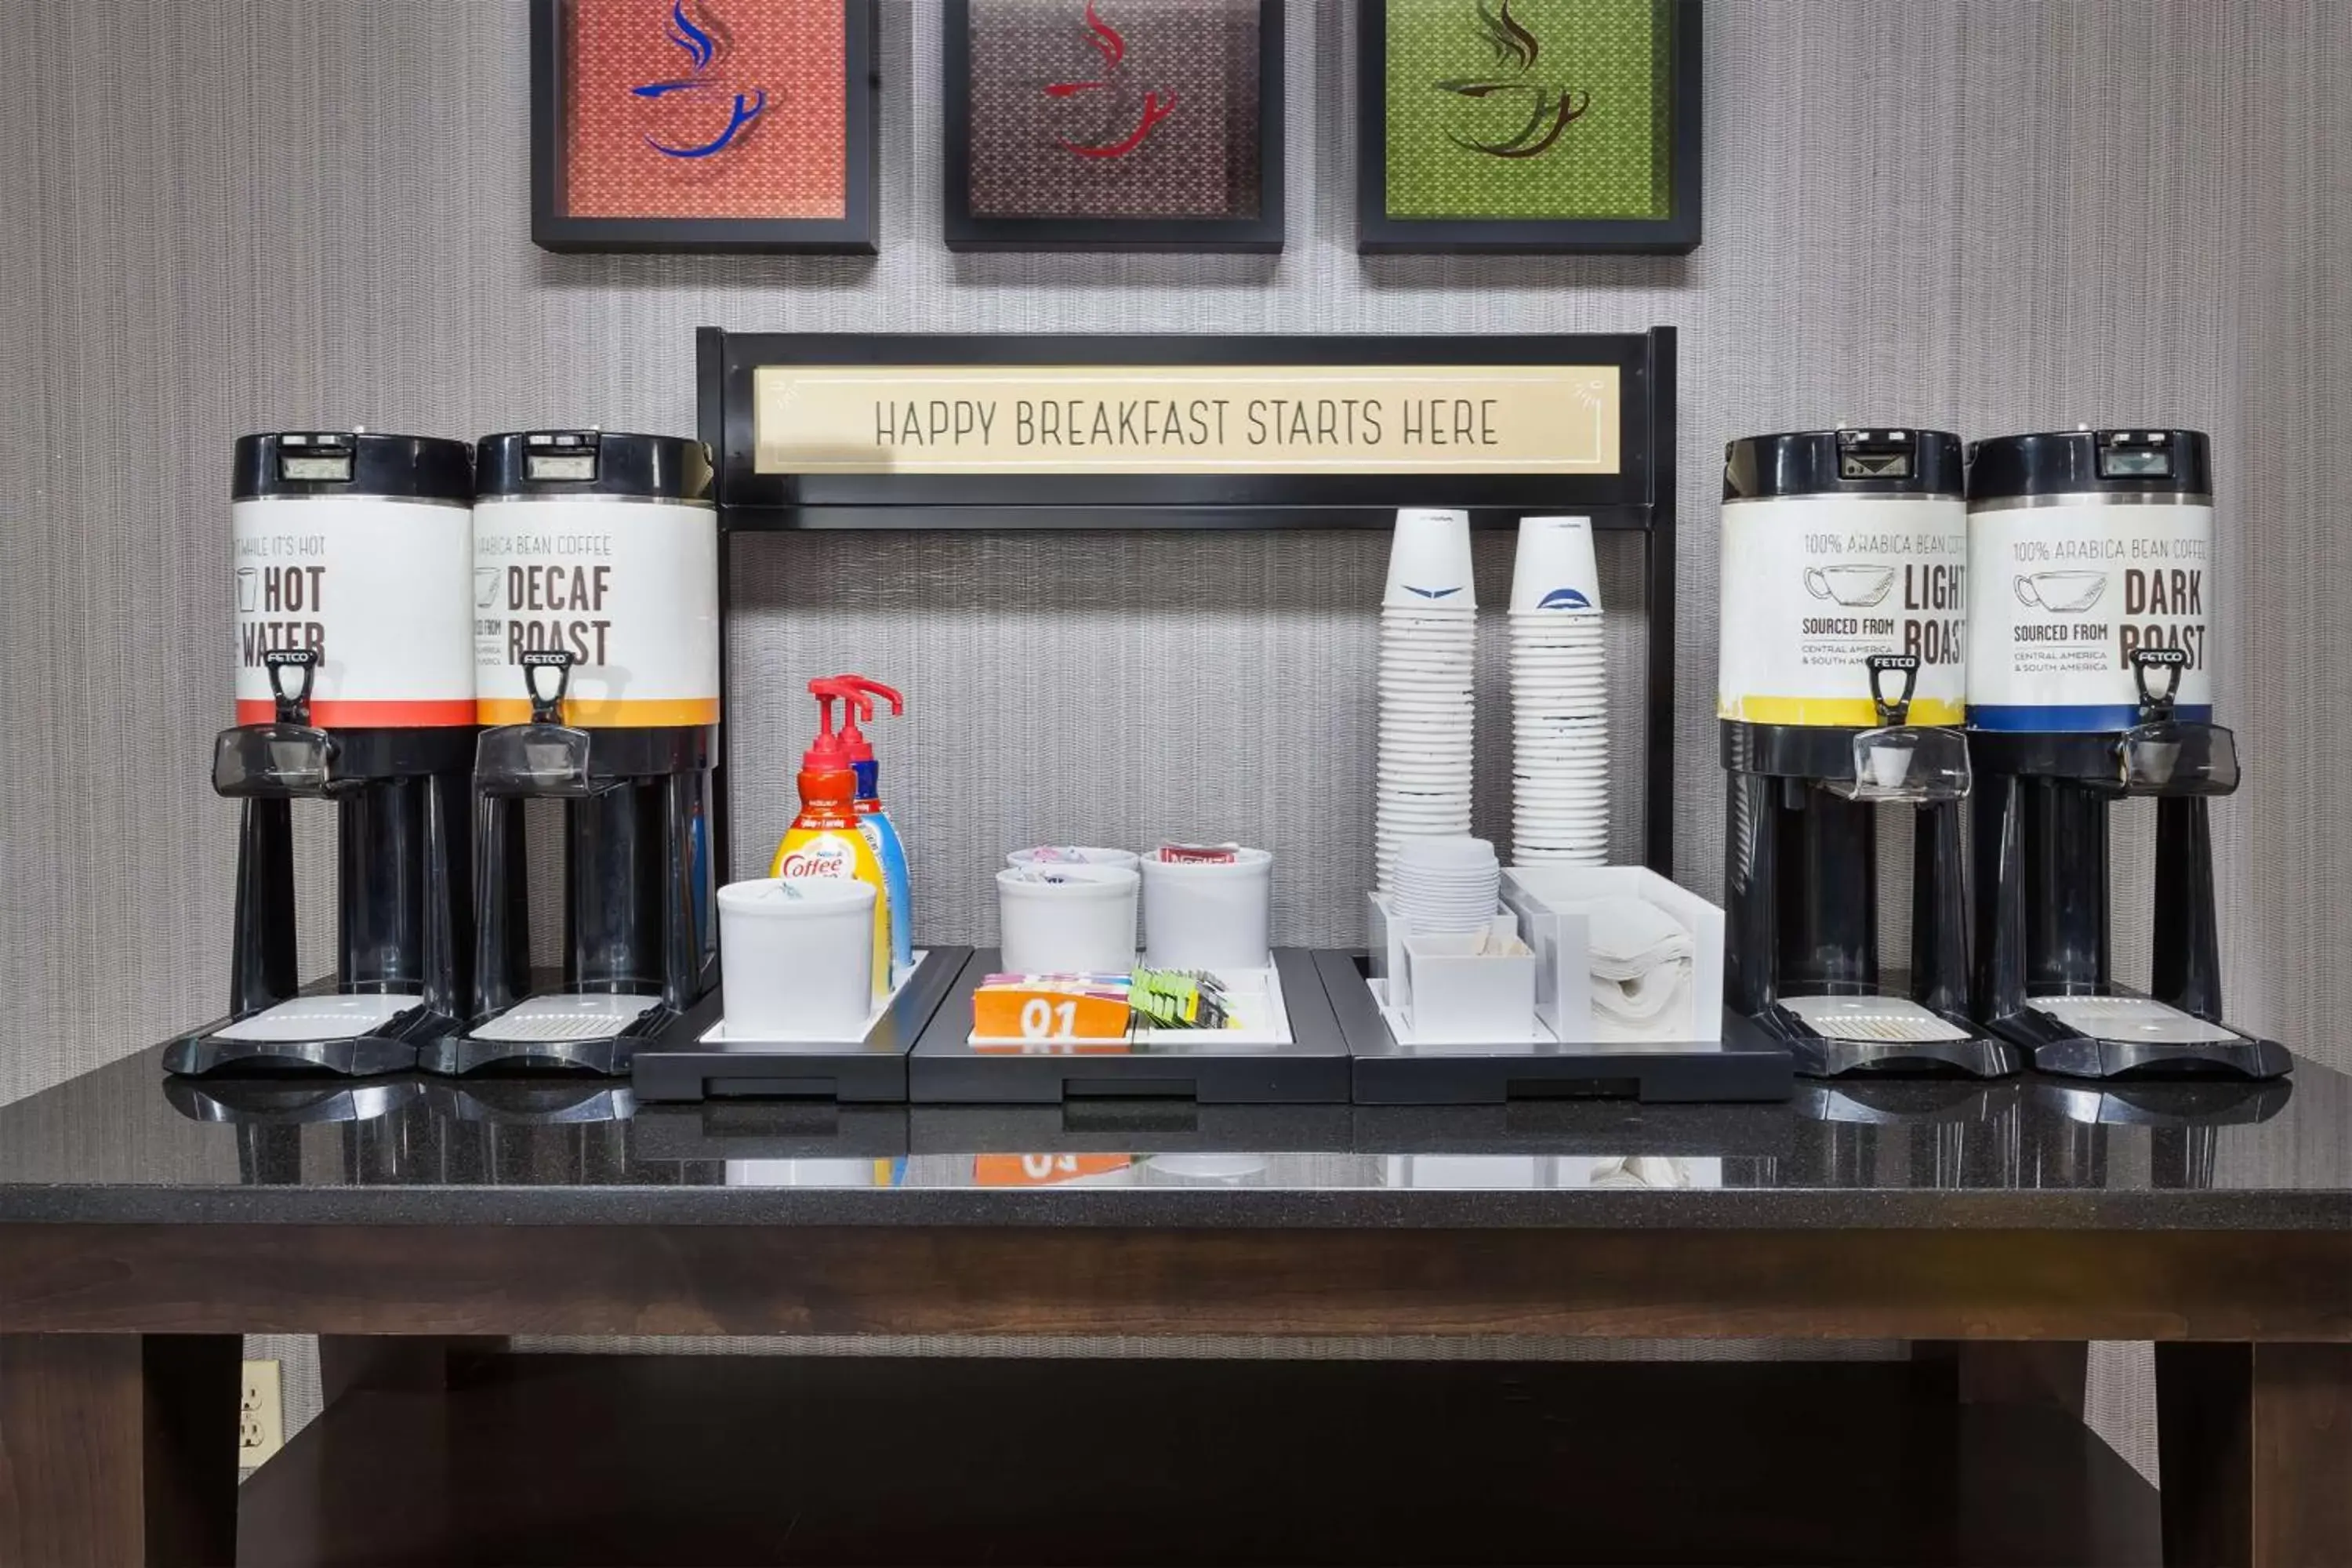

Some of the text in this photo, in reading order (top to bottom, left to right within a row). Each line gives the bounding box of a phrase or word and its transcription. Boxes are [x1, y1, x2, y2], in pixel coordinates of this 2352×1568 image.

[875, 398, 1499, 447] HAPPY BREAKFAST STARTS HERE
[271, 535, 294, 556] IT'S
[299, 535, 326, 556] HOT
[516, 535, 551, 555] BEAN
[557, 535, 612, 556] COFFEE
[1805, 534, 1842, 554] 100%
[1846, 534, 1913, 554] ARABICA
[1916, 534, 1946, 554] BEAN
[2013, 539, 2207, 561] 100% ARABICA BEAN COFFEE
[264, 566, 326, 612] HOT
[508, 565, 612, 611] DECAF
[2125, 569, 2202, 615] DARK
[1802, 618, 1894, 635] SOURCED FROM
[2014, 624, 2109, 642] SOURCED FROM
[242, 622, 325, 667] WATER
[508, 620, 612, 666] ROAST
[1802, 644, 1893, 655] CENTRAL AMERICA
[2120, 624, 2206, 671] ROAST
[267, 652, 310, 662] FETCO
[524, 654, 566, 664] FETCO
[1812, 657, 1846, 666] SOUTH
[1874, 657, 1916, 667] FETCO
[2013, 651, 2108, 661] CENTRAL AMERICA
[2137, 652, 2183, 662] FETCO
[2023, 663, 2056, 672] SOUTH
[2059, 662, 2108, 672] AMERICA
[782, 854, 844, 878] Coffee
[1021, 998, 1078, 1039] 01
